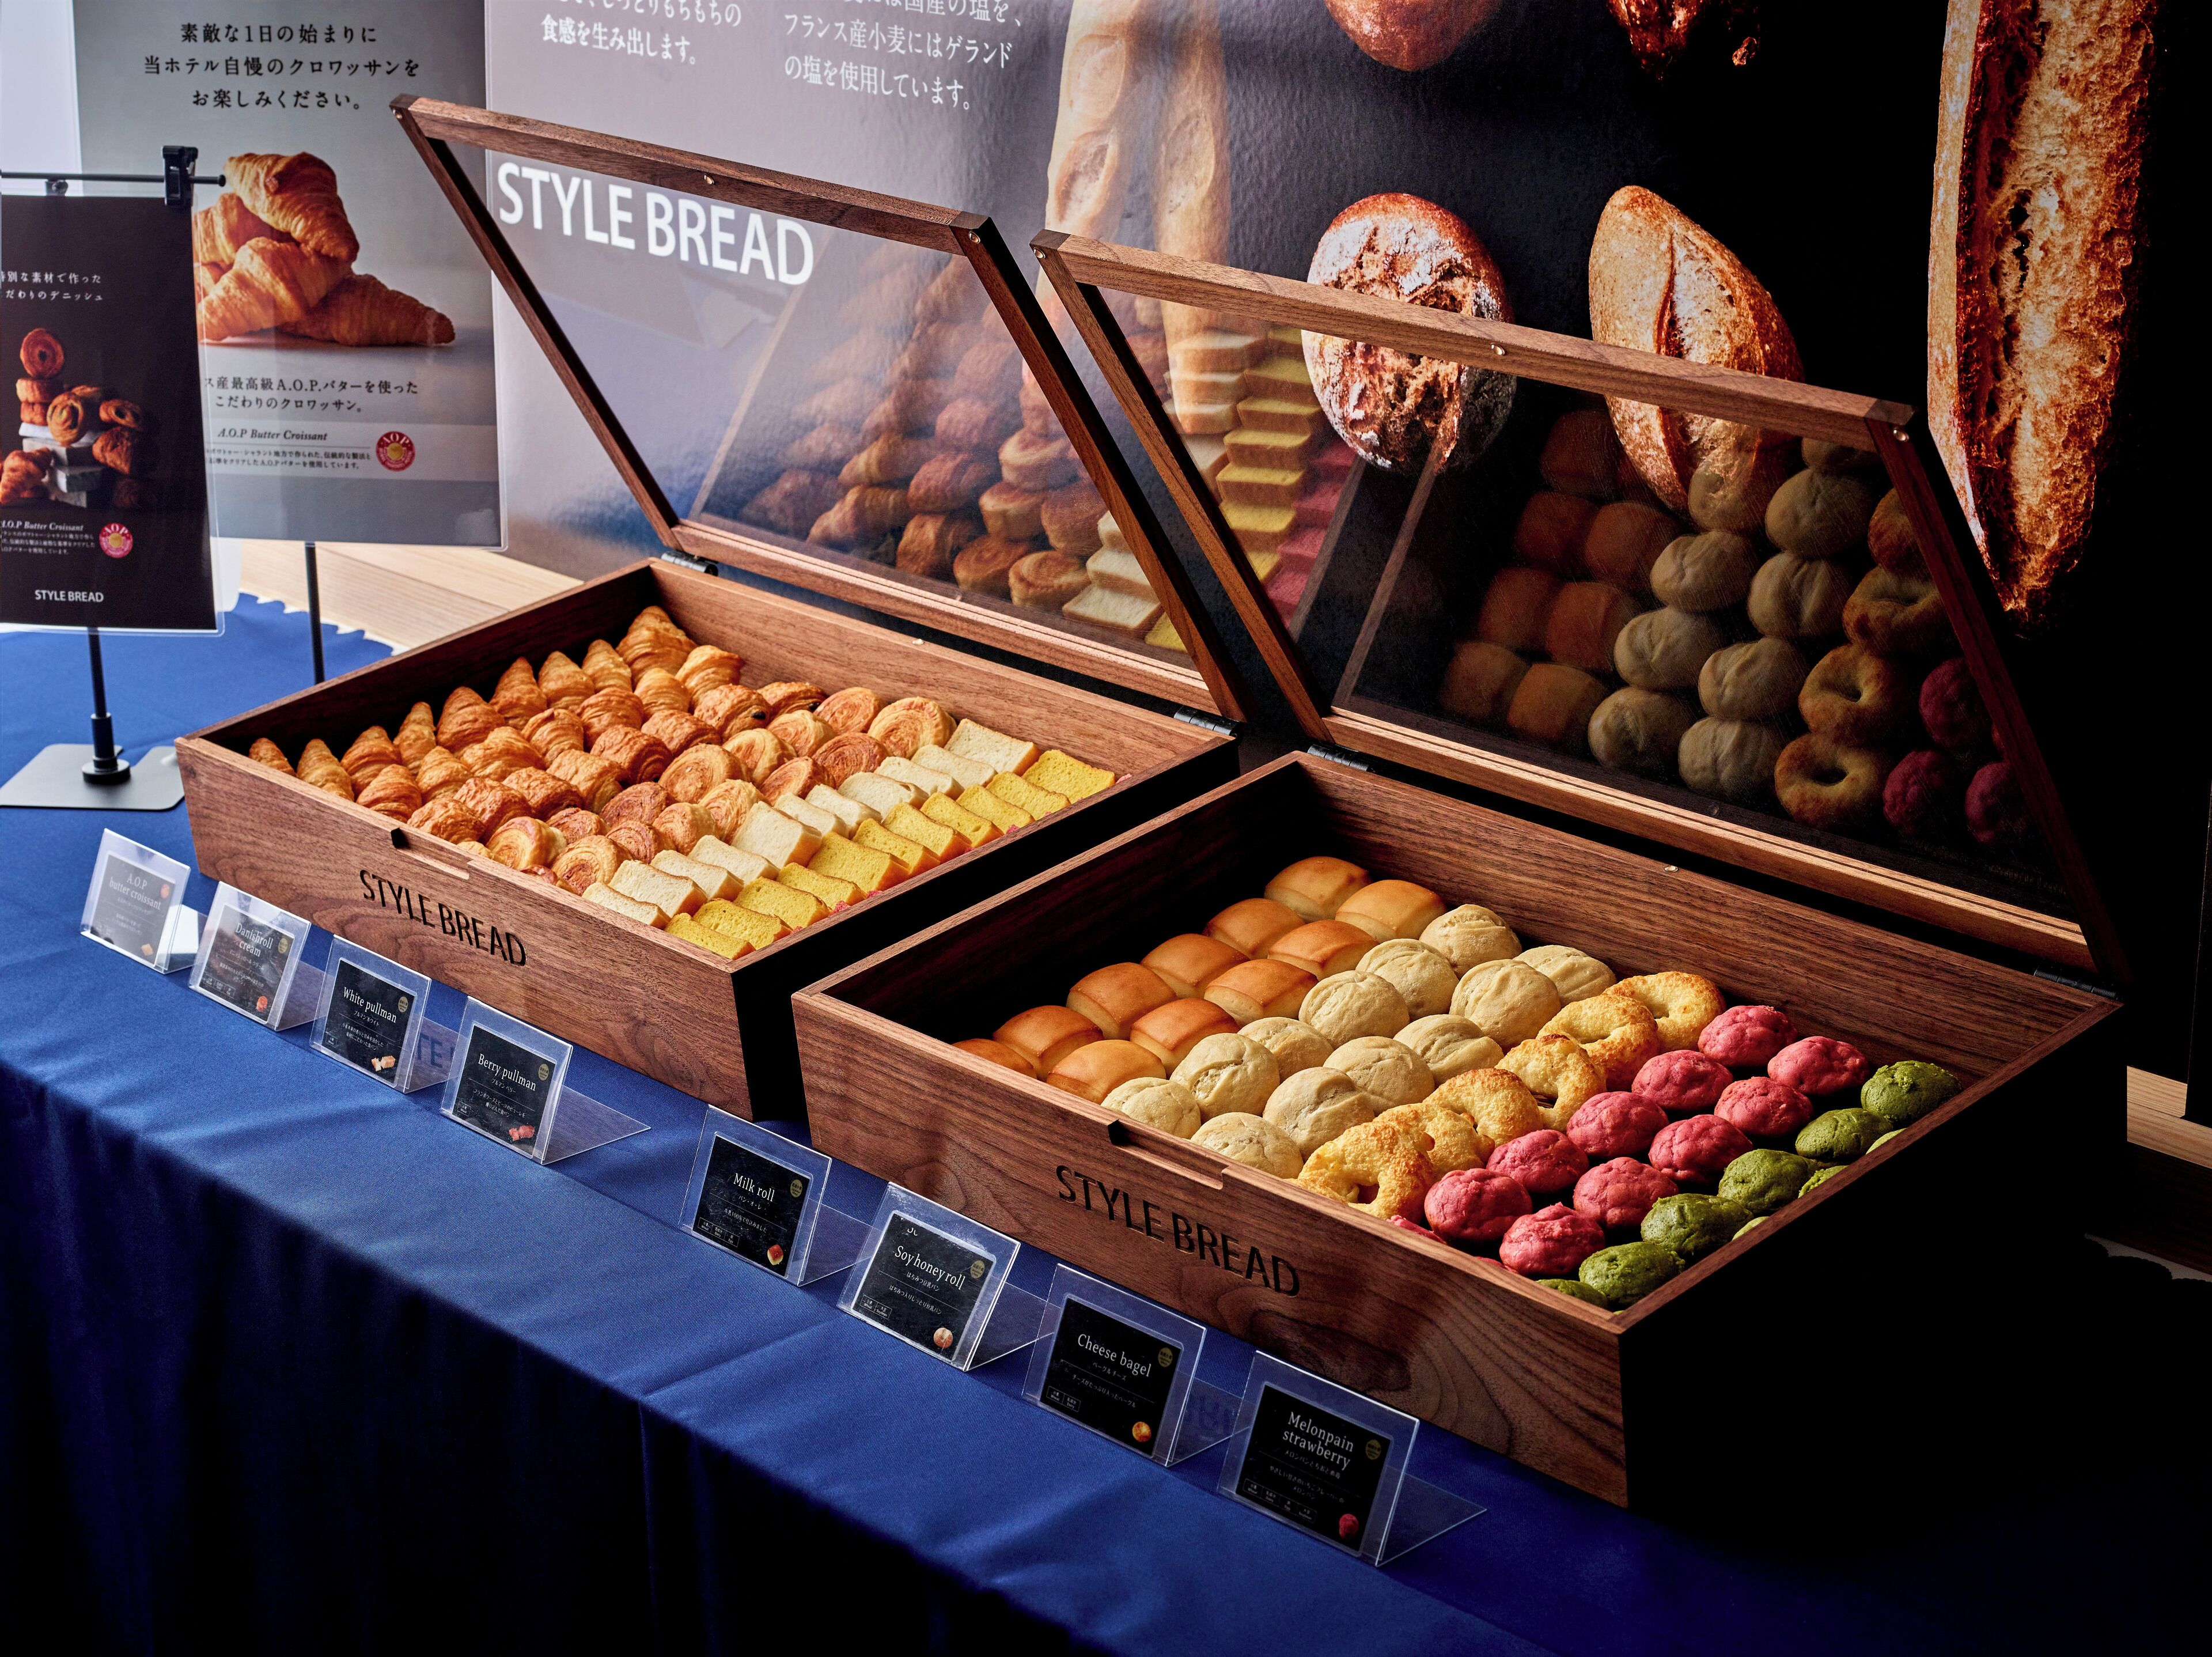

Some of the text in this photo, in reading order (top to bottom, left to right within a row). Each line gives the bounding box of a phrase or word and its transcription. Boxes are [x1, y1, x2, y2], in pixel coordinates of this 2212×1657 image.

[181, 24, 376, 44] 素敵な1日の始まりに
[541, 14, 695, 65] 食感を生み出します。
[785, 14, 1012, 69] フランス産小麦にはゲランド
[145, 56, 419, 77] 当ホテル自慢のクロワッサンを
[785, 55, 969, 110] の塩を使用しています。
[192, 89, 359, 110] お楽しみください。
[497, 162, 814, 285] STYLE BREAD
[215, 395, 361, 413] こだわりのクロワッサン。
[218, 429, 327, 441] A.O.P Butter Croissant
[24, 521, 47, 529] Butter
[50, 523, 84, 531] Croissant
[35, 589, 104, 602] STYLE BREAD
[109, 876, 130, 895] butter
[130, 890, 161, 910] croissant
[127, 873, 147, 890] A.O.P
[359, 869, 527, 967] STYLE BREAD
[236, 922, 274, 949] Danishroll
[239, 940, 261, 957] cream
[343, 986, 364, 1007] White
[365, 1001, 396, 1023] pullman
[478, 1053, 501, 1076] Berry
[502, 1068, 536, 1091] pullman
[733, 1173, 755, 1193] Milk
[757, 1187, 775, 1202] roll
[1056, 1165, 1300, 1297] STYLE BREAD
[895, 1246, 965, 1290] Soy honey roll
[907, 1272, 940, 1291] はちみつ豆乳パン
[1078, 1334, 1117, 1362] Cheese
[1120, 1352, 1152, 1377] bagel
[1288, 1412, 1354, 1452] Melonpain
[1282, 1431, 1351, 1470] strawberry
